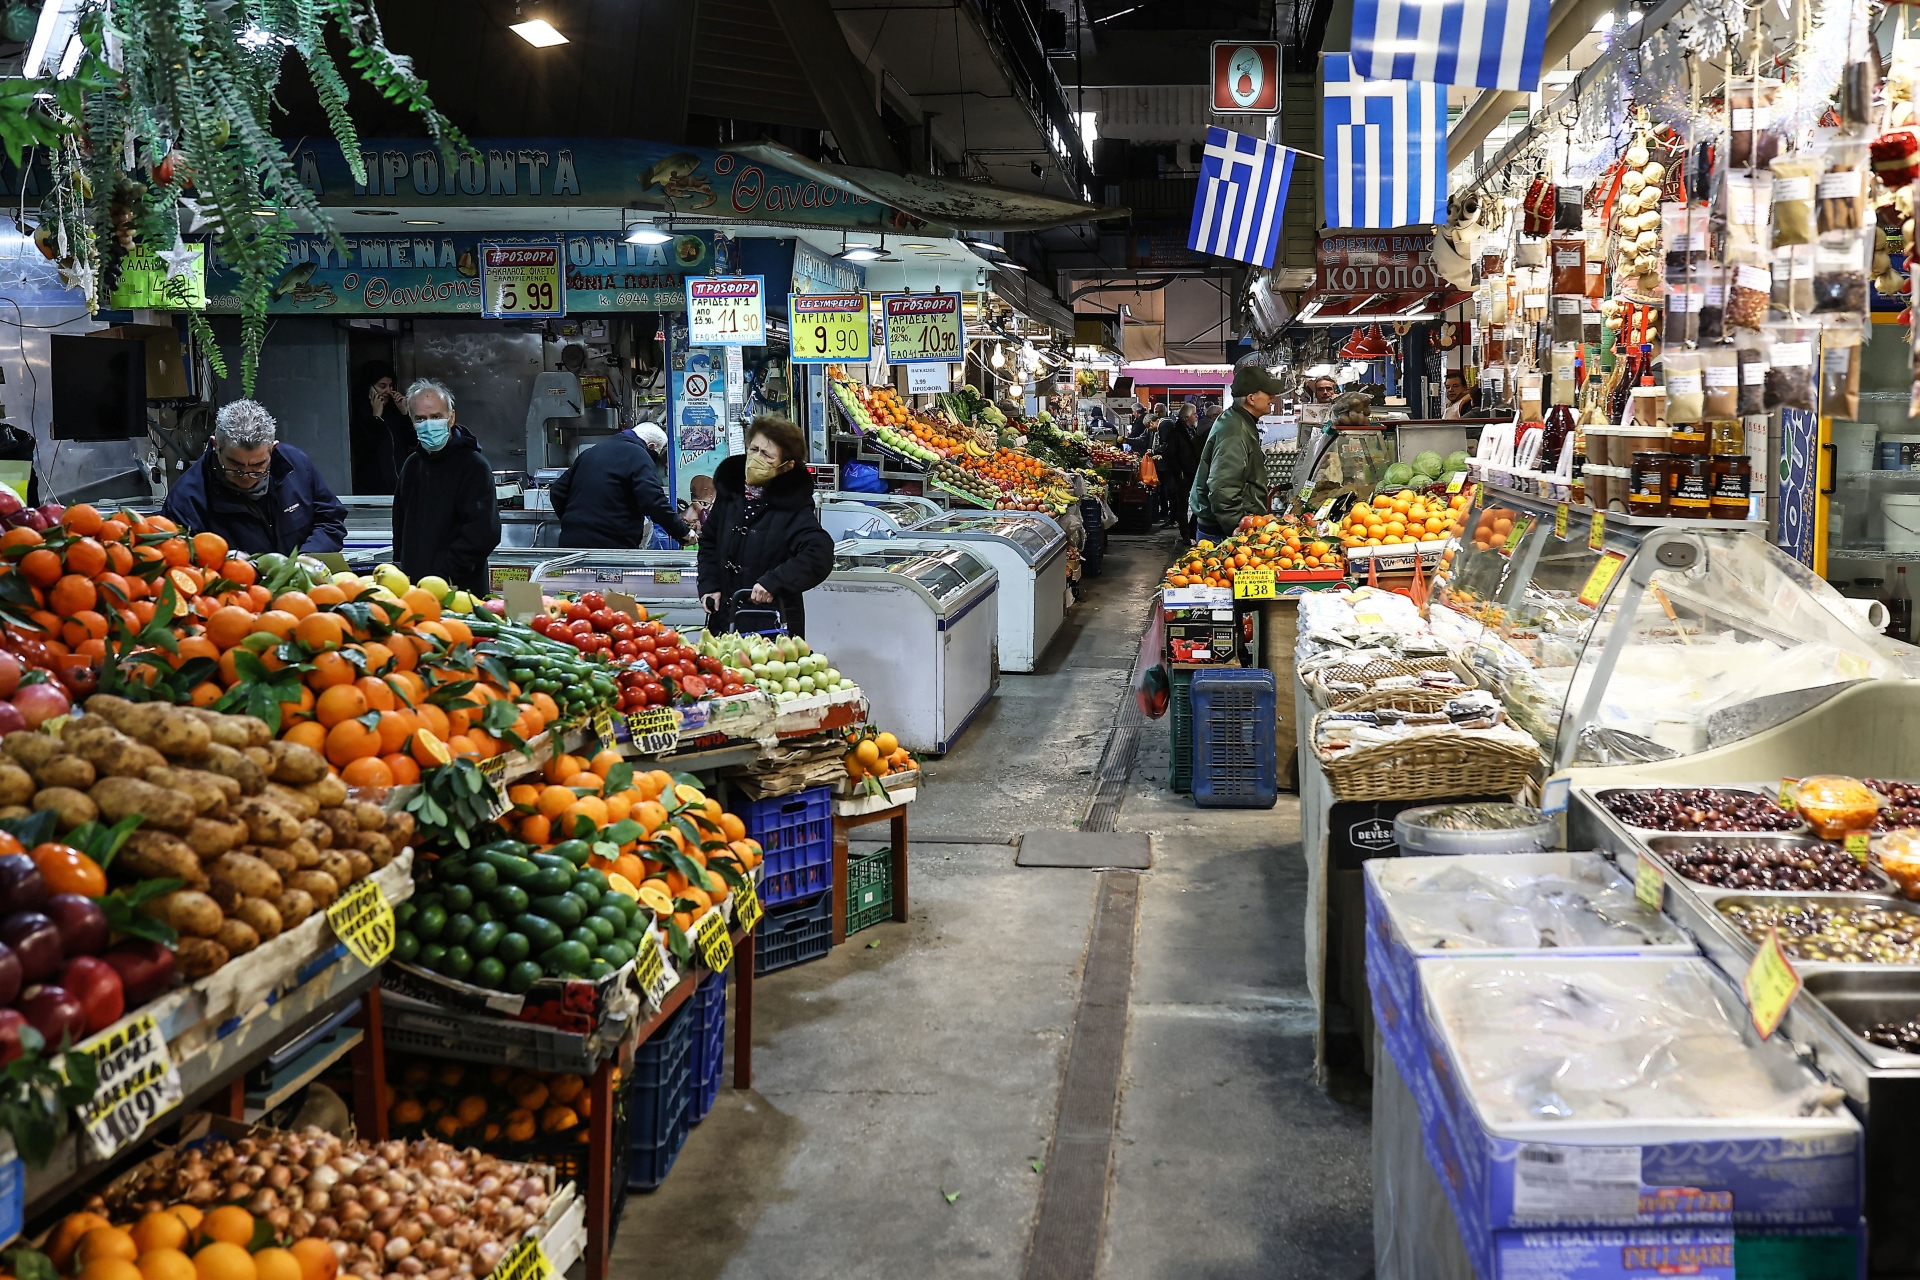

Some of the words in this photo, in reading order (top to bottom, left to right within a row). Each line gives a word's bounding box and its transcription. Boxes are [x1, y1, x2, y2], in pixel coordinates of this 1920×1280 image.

[1322, 237, 1388, 253] ΦΡΕΣΚΑ
[491, 251, 554, 263] ΠΡΟΣΦΟΡΑ
[529, 267, 556, 276] ΦΙΛΕΤΟ
[696, 283, 756, 294] ΠΡΟΣΦΟΡΑ
[502, 282, 553, 311] 5.99
[617, 292, 649, 306] 6944
[692, 298, 729, 307] ΓΑΡΙΔΕΣ
[800, 300, 813, 308] ΣΕ
[813, 299, 861, 309] ΣΥΜΦΕΡΕΙ!
[892, 299, 953, 312] ΠΡΟΣΦΟΡΑ
[795, 313, 835, 324] ΓΑΡΙΔΑ
[889, 314, 928, 325] ΓΑΡΙΔΕΣ
[814, 326, 859, 354] 9.90
[1241, 584, 1268, 597] 1.38
[1522, 1230, 1626, 1247] WETSALTED
[1628, 1230, 1667, 1246] FISH
[1670, 1230, 1694, 1245] OF
